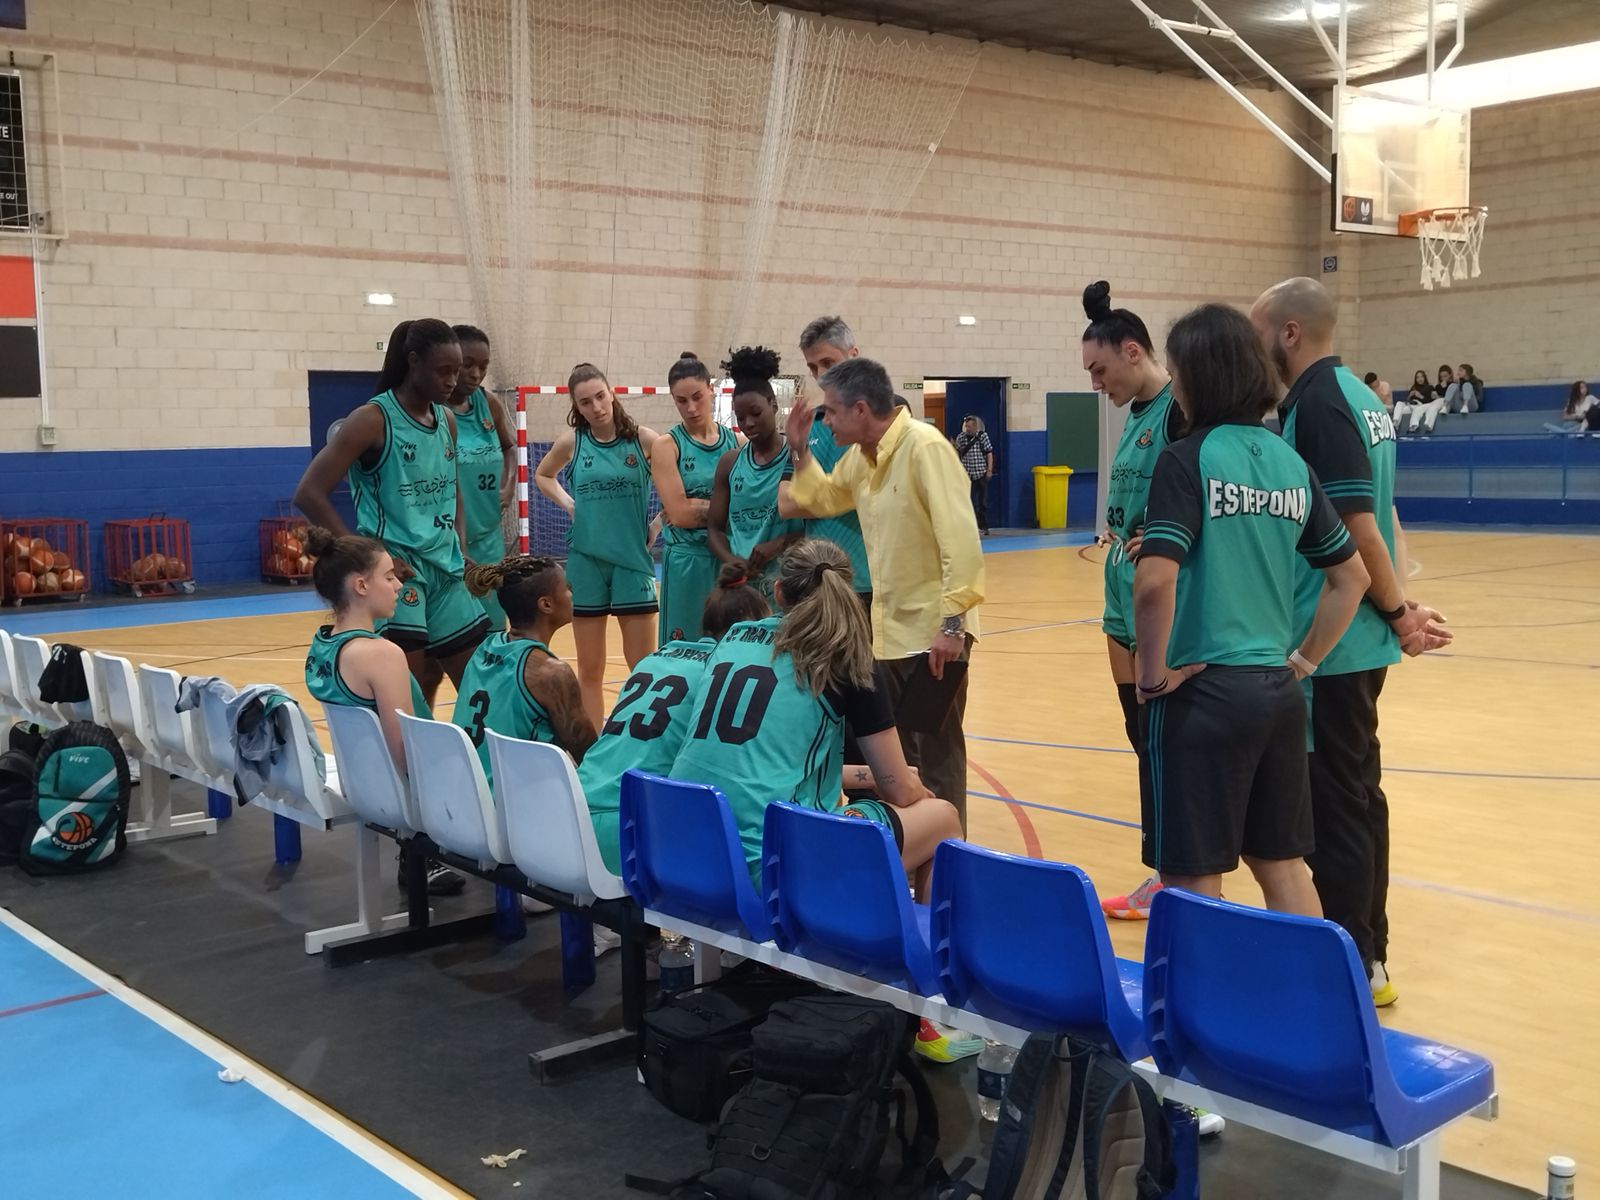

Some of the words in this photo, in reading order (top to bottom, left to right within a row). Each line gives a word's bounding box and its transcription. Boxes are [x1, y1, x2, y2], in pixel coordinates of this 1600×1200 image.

[478, 474, 497, 491] 32
[1208, 478, 1306, 525] ESTEPONA
[433, 513, 454, 530] 45
[1107, 506, 1125, 529] 33
[463, 689, 491, 749] 3
[602, 671, 690, 742] 23
[693, 662, 778, 745] 10
